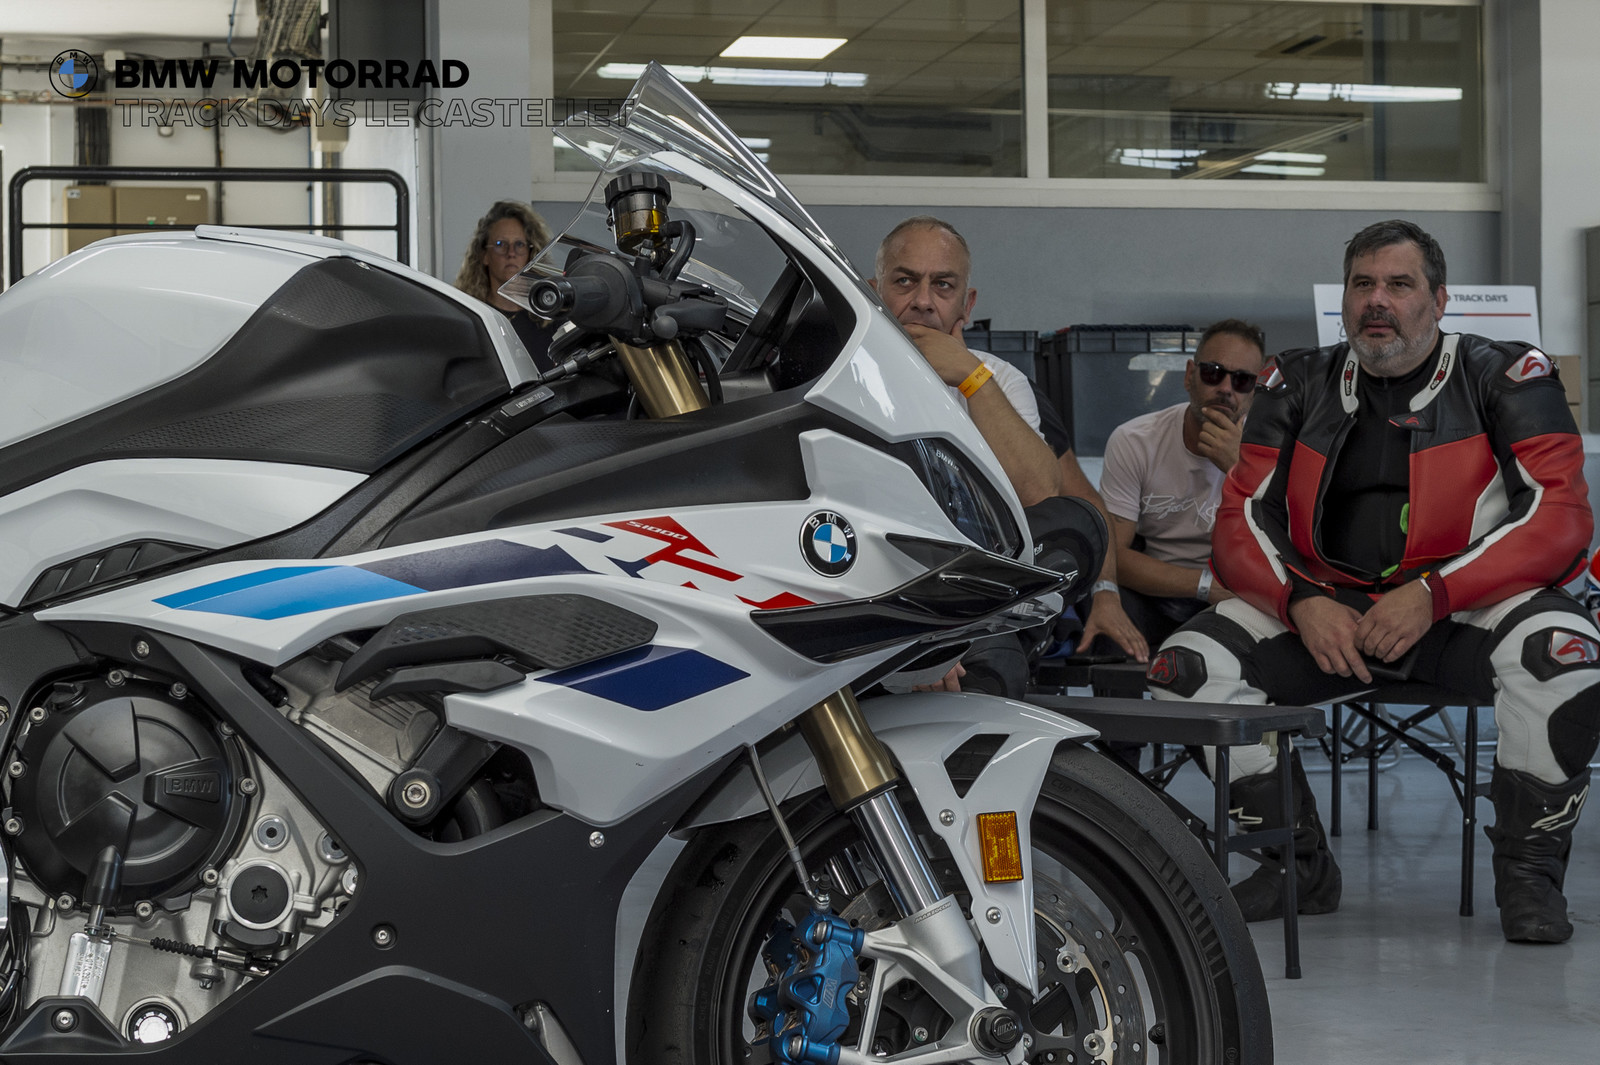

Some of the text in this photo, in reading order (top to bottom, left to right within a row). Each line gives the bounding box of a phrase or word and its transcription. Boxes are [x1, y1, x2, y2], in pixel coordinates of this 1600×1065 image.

[1454, 294, 1484, 303] TRACK
[1486, 294, 1508, 303] DAYS
[935, 448, 953, 466] BMW
[625, 520, 689, 541] S1000
[807, 512, 854, 538] BMW
[169, 777, 215, 794] BMW
